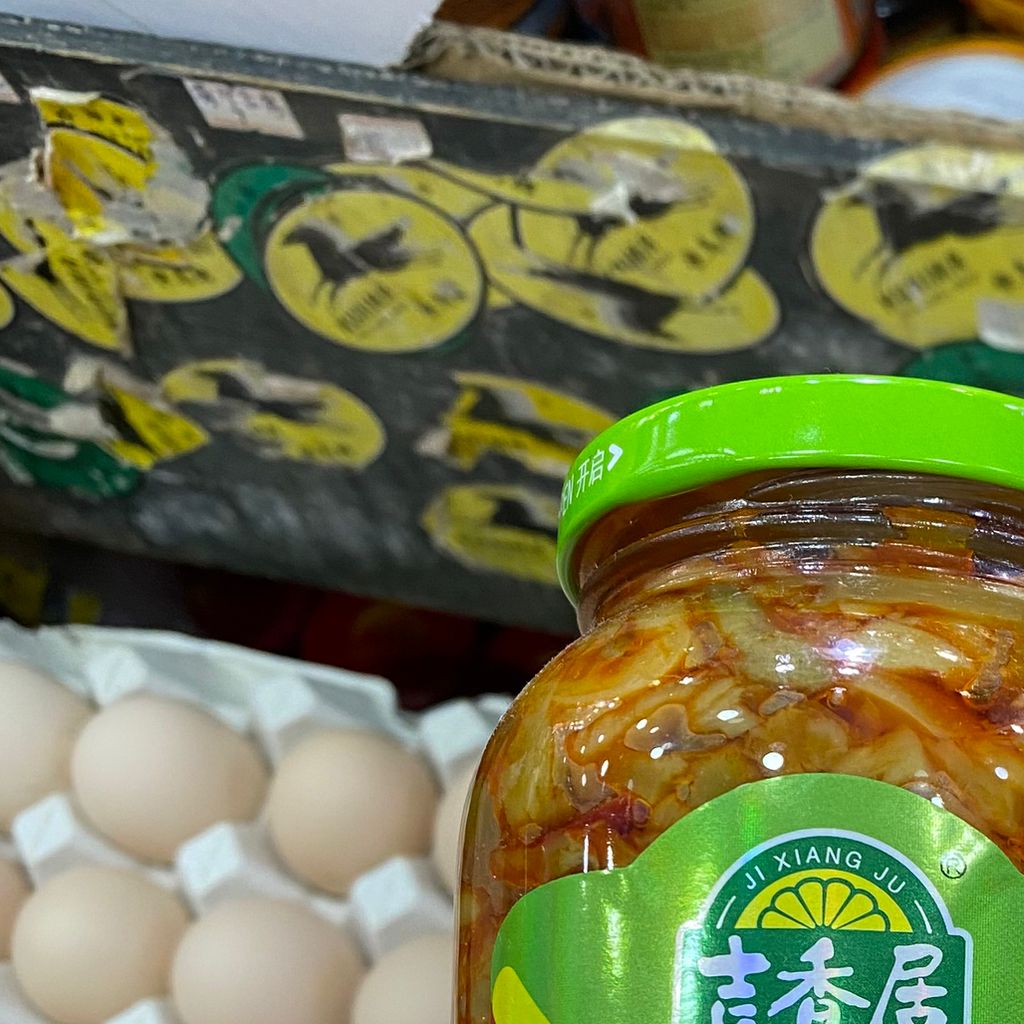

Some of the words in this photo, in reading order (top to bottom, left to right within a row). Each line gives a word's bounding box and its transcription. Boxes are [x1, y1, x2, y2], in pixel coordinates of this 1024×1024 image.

[576, 449, 605, 498] 开启
[744, 866, 765, 891] JI
[772, 847, 862, 872] XIANG
[873, 866, 907, 894] JU
